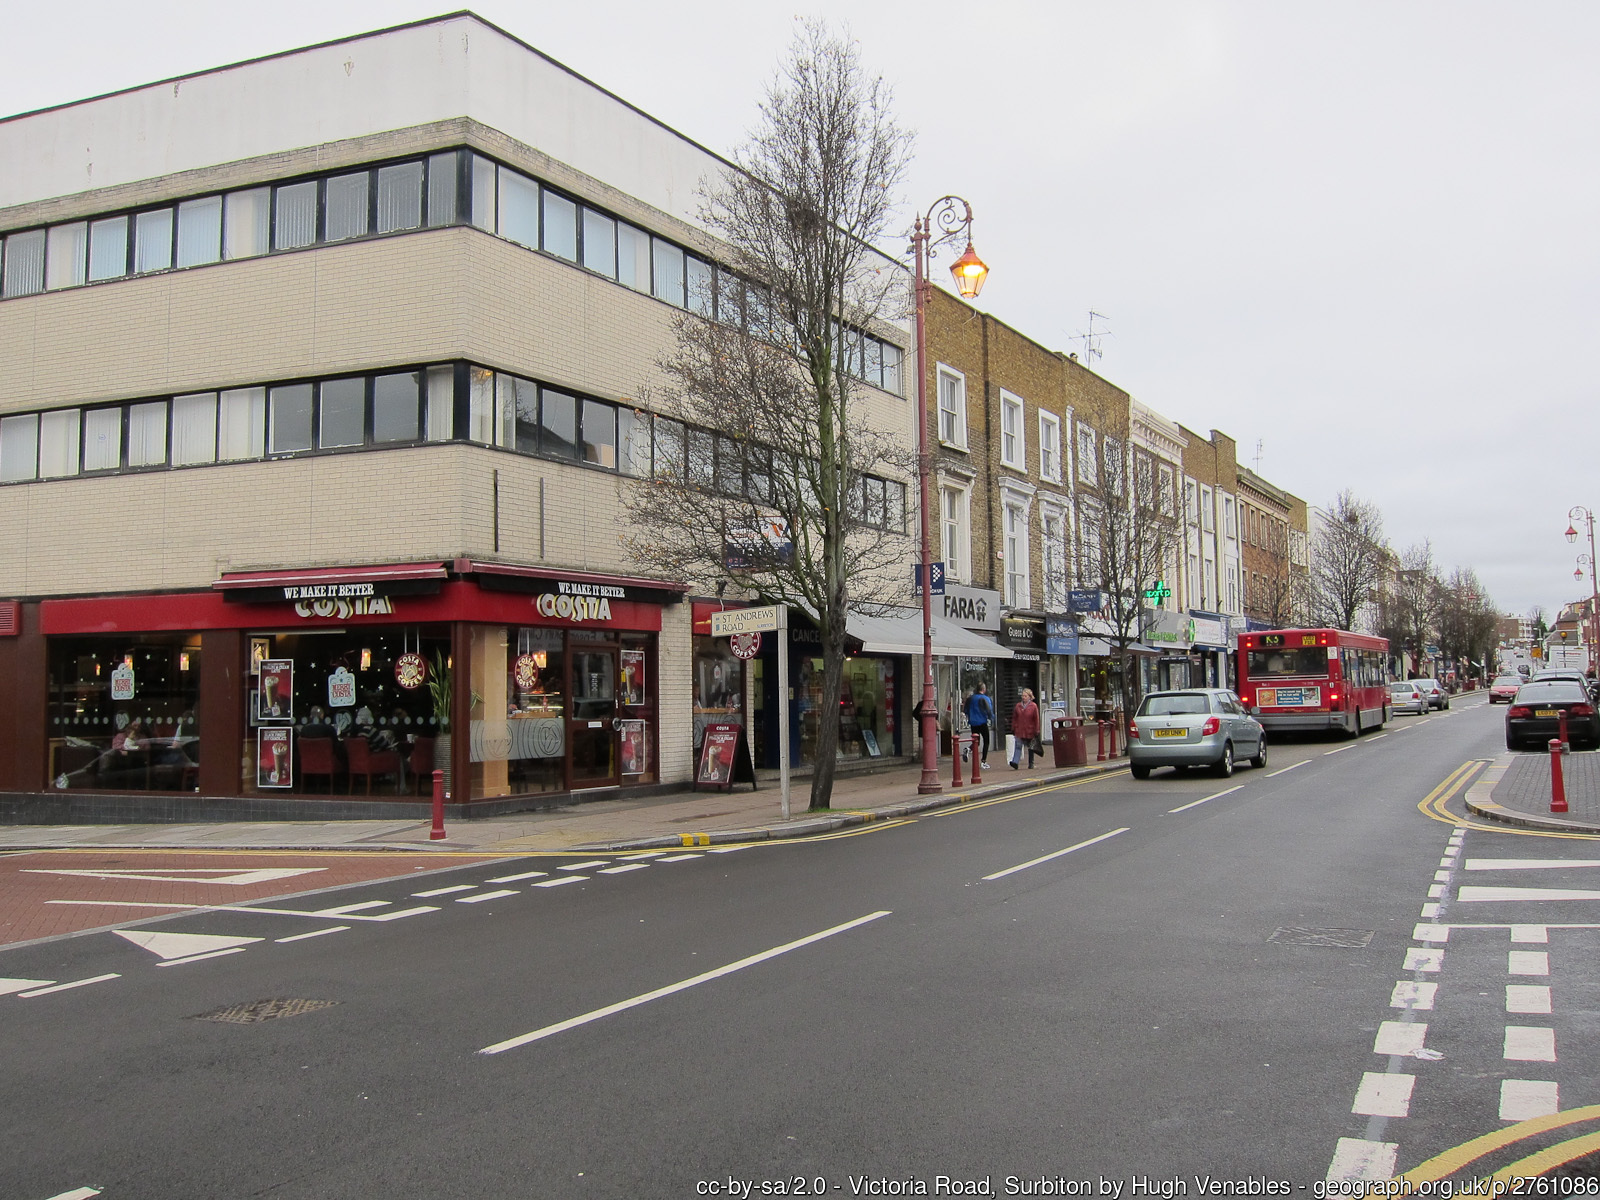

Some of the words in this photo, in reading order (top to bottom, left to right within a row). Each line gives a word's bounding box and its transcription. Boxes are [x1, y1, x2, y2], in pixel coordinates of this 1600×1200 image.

[284, 587, 299, 599] WE
[300, 585, 327, 598] MAKE
[327, 585, 338, 597] IT
[339, 583, 375, 596] BETTER
[557, 581, 571, 594] WE
[571, 583, 592, 596] MAKE
[592, 584, 600, 596] IT
[600, 586, 626, 598] BETTER
[537, 593, 613, 622] COSTA
[943, 595, 976, 620] FARA
[722, 614, 732, 623] ST
[734, 609, 774, 622] ANDREWS
[722, 622, 744, 633] ROAD
[1265, 635, 1279, 645] K3
[732, 644, 758, 658] COFFEE
[398, 655, 420, 667] COSTA
[518, 656, 535, 668] COSTA
[397, 673, 424, 688] COFFEE
[516, 674, 536, 688] COFFEE
